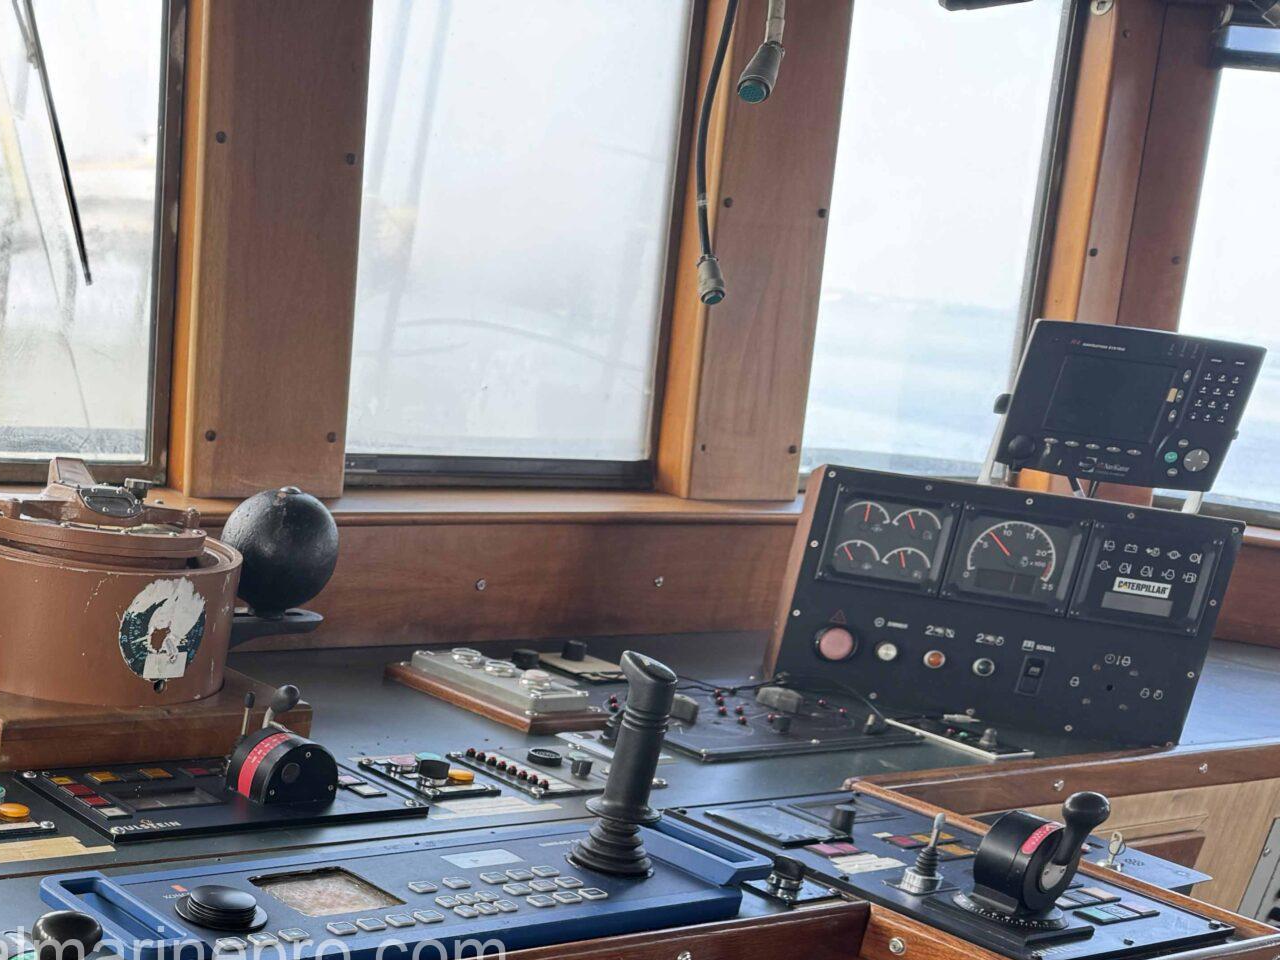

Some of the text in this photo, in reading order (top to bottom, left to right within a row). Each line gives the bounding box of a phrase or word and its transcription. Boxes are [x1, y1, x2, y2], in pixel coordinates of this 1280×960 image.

[1003, 529, 1013, 537] 10
[1025, 532, 1036, 540] 15
[1035, 549, 1047, 557] 20
[1041, 582, 1054, 592] 25
[1117, 580, 1169, 595] CATERPILLAR
[123, 819, 183, 832] ULSTEIN
